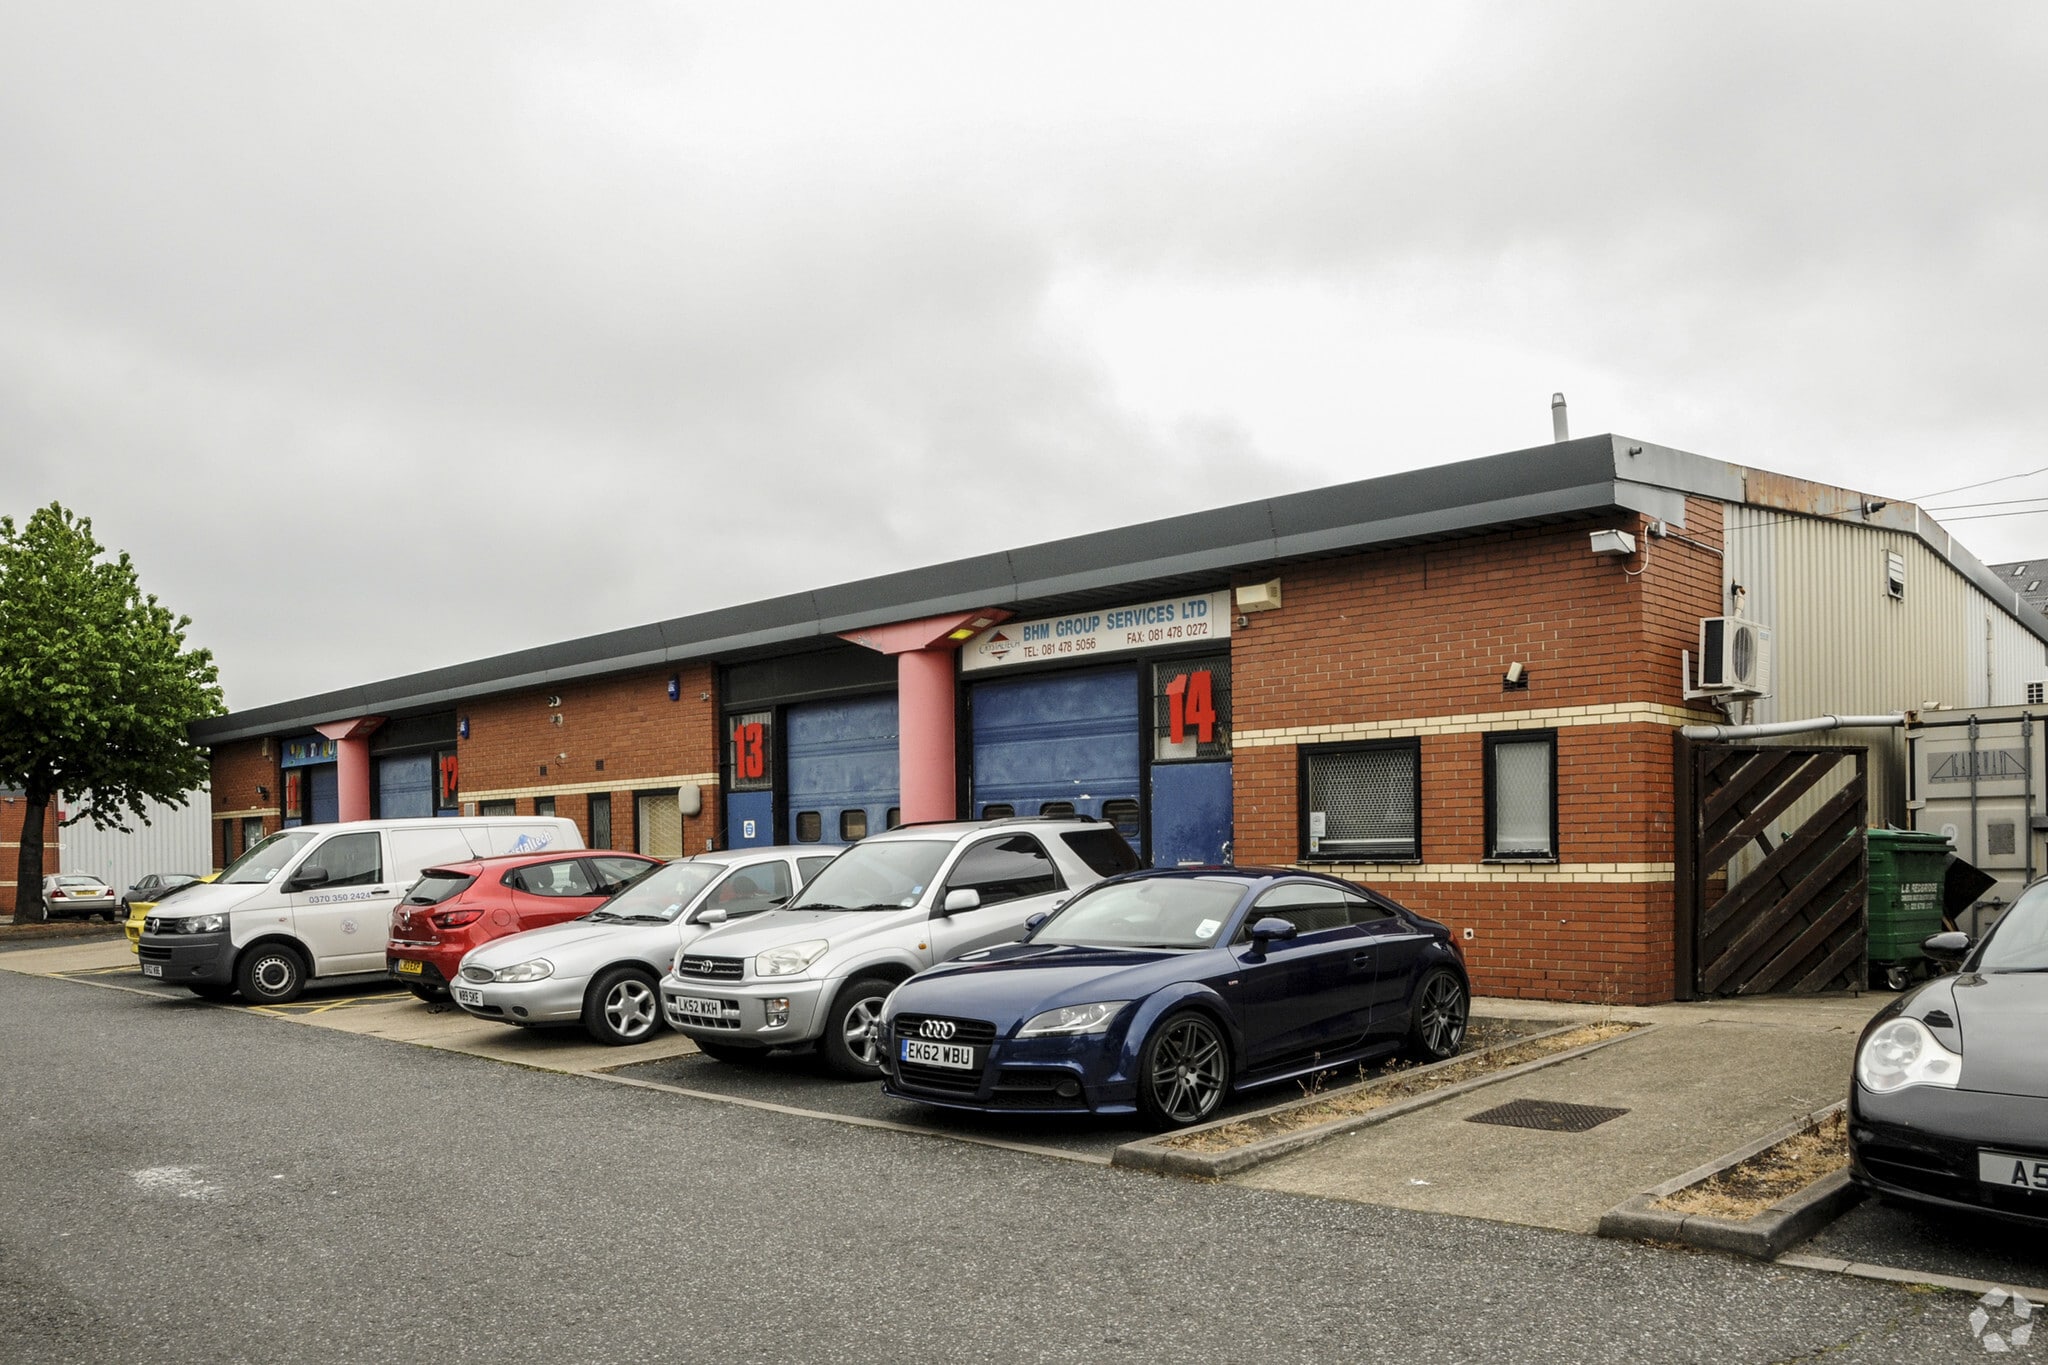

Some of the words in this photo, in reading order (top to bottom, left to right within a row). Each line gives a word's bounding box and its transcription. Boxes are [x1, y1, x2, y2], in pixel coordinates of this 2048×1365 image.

[1023, 622, 1050, 642] BHM
[1056, 615, 1100, 638] GROUP
[1106, 604, 1175, 630] SERVICES
[1182, 599, 1207, 620] LTD
[1127, 631, 1145, 645] FAX:
[1148, 628, 1163, 642] 081
[1167, 625, 1182, 639] 478
[1186, 622, 1208, 637] 0272
[1024, 646, 1039, 658] TEL:
[1041, 643, 1055, 656] 081
[1058, 641, 1072, 653] 478
[1076, 637, 1096, 651] 5056
[1165, 669, 1216, 744] 14
[733, 722, 763, 778] 13
[441, 755, 458, 798] 17
[287, 775, 297, 810] 11
[309, 895, 330, 903] 0370
[332, 894, 348, 902] 350
[350, 892, 370, 900] 2424
[680, 998, 699, 1013] LK52
[700, 1001, 718, 1015] WXH
[908, 1042, 939, 1061] EK62
[943, 1046, 970, 1065] WBU
[2011, 1160, 2048, 1188] A5
